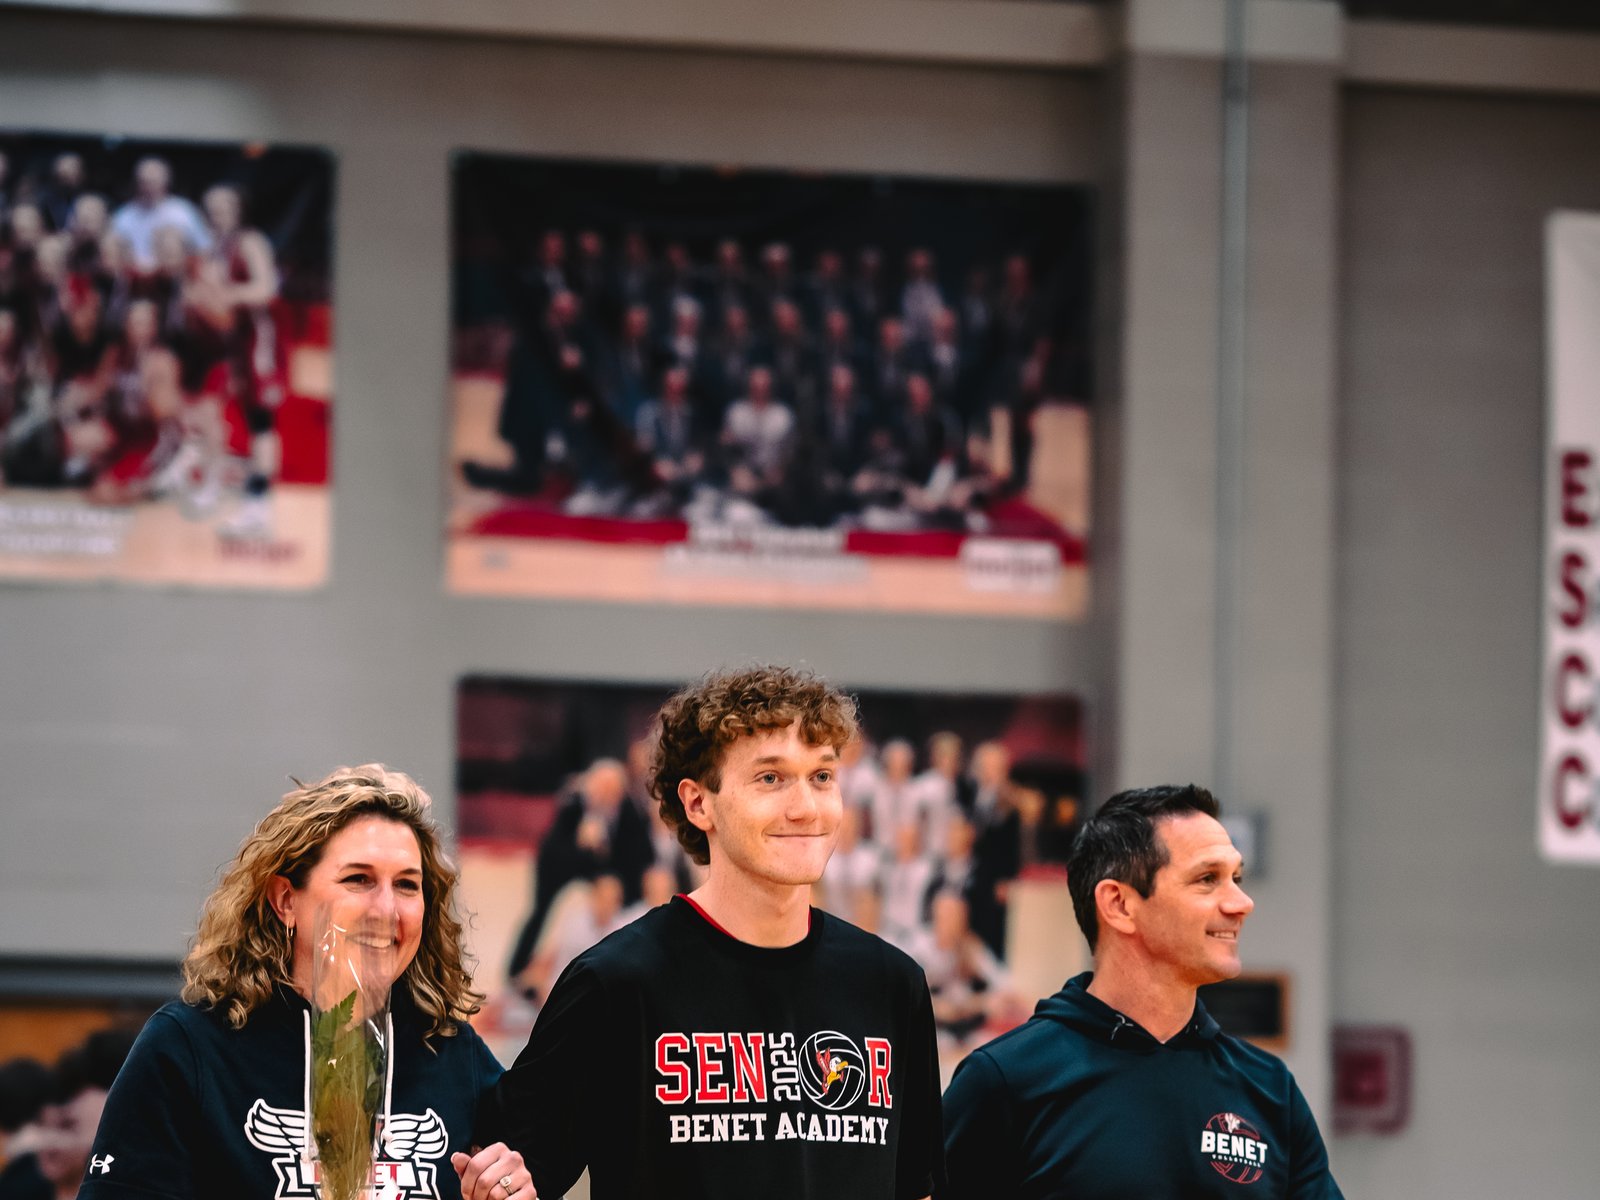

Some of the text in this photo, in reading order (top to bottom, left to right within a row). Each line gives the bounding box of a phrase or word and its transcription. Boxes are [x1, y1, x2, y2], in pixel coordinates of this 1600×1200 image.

[1555, 451, 1592, 830] ESCC
[768, 1032, 800, 1102] 2025
[669, 1111, 889, 1145] BENET ACADEMY
[1200, 1130, 1268, 1164] BENET
